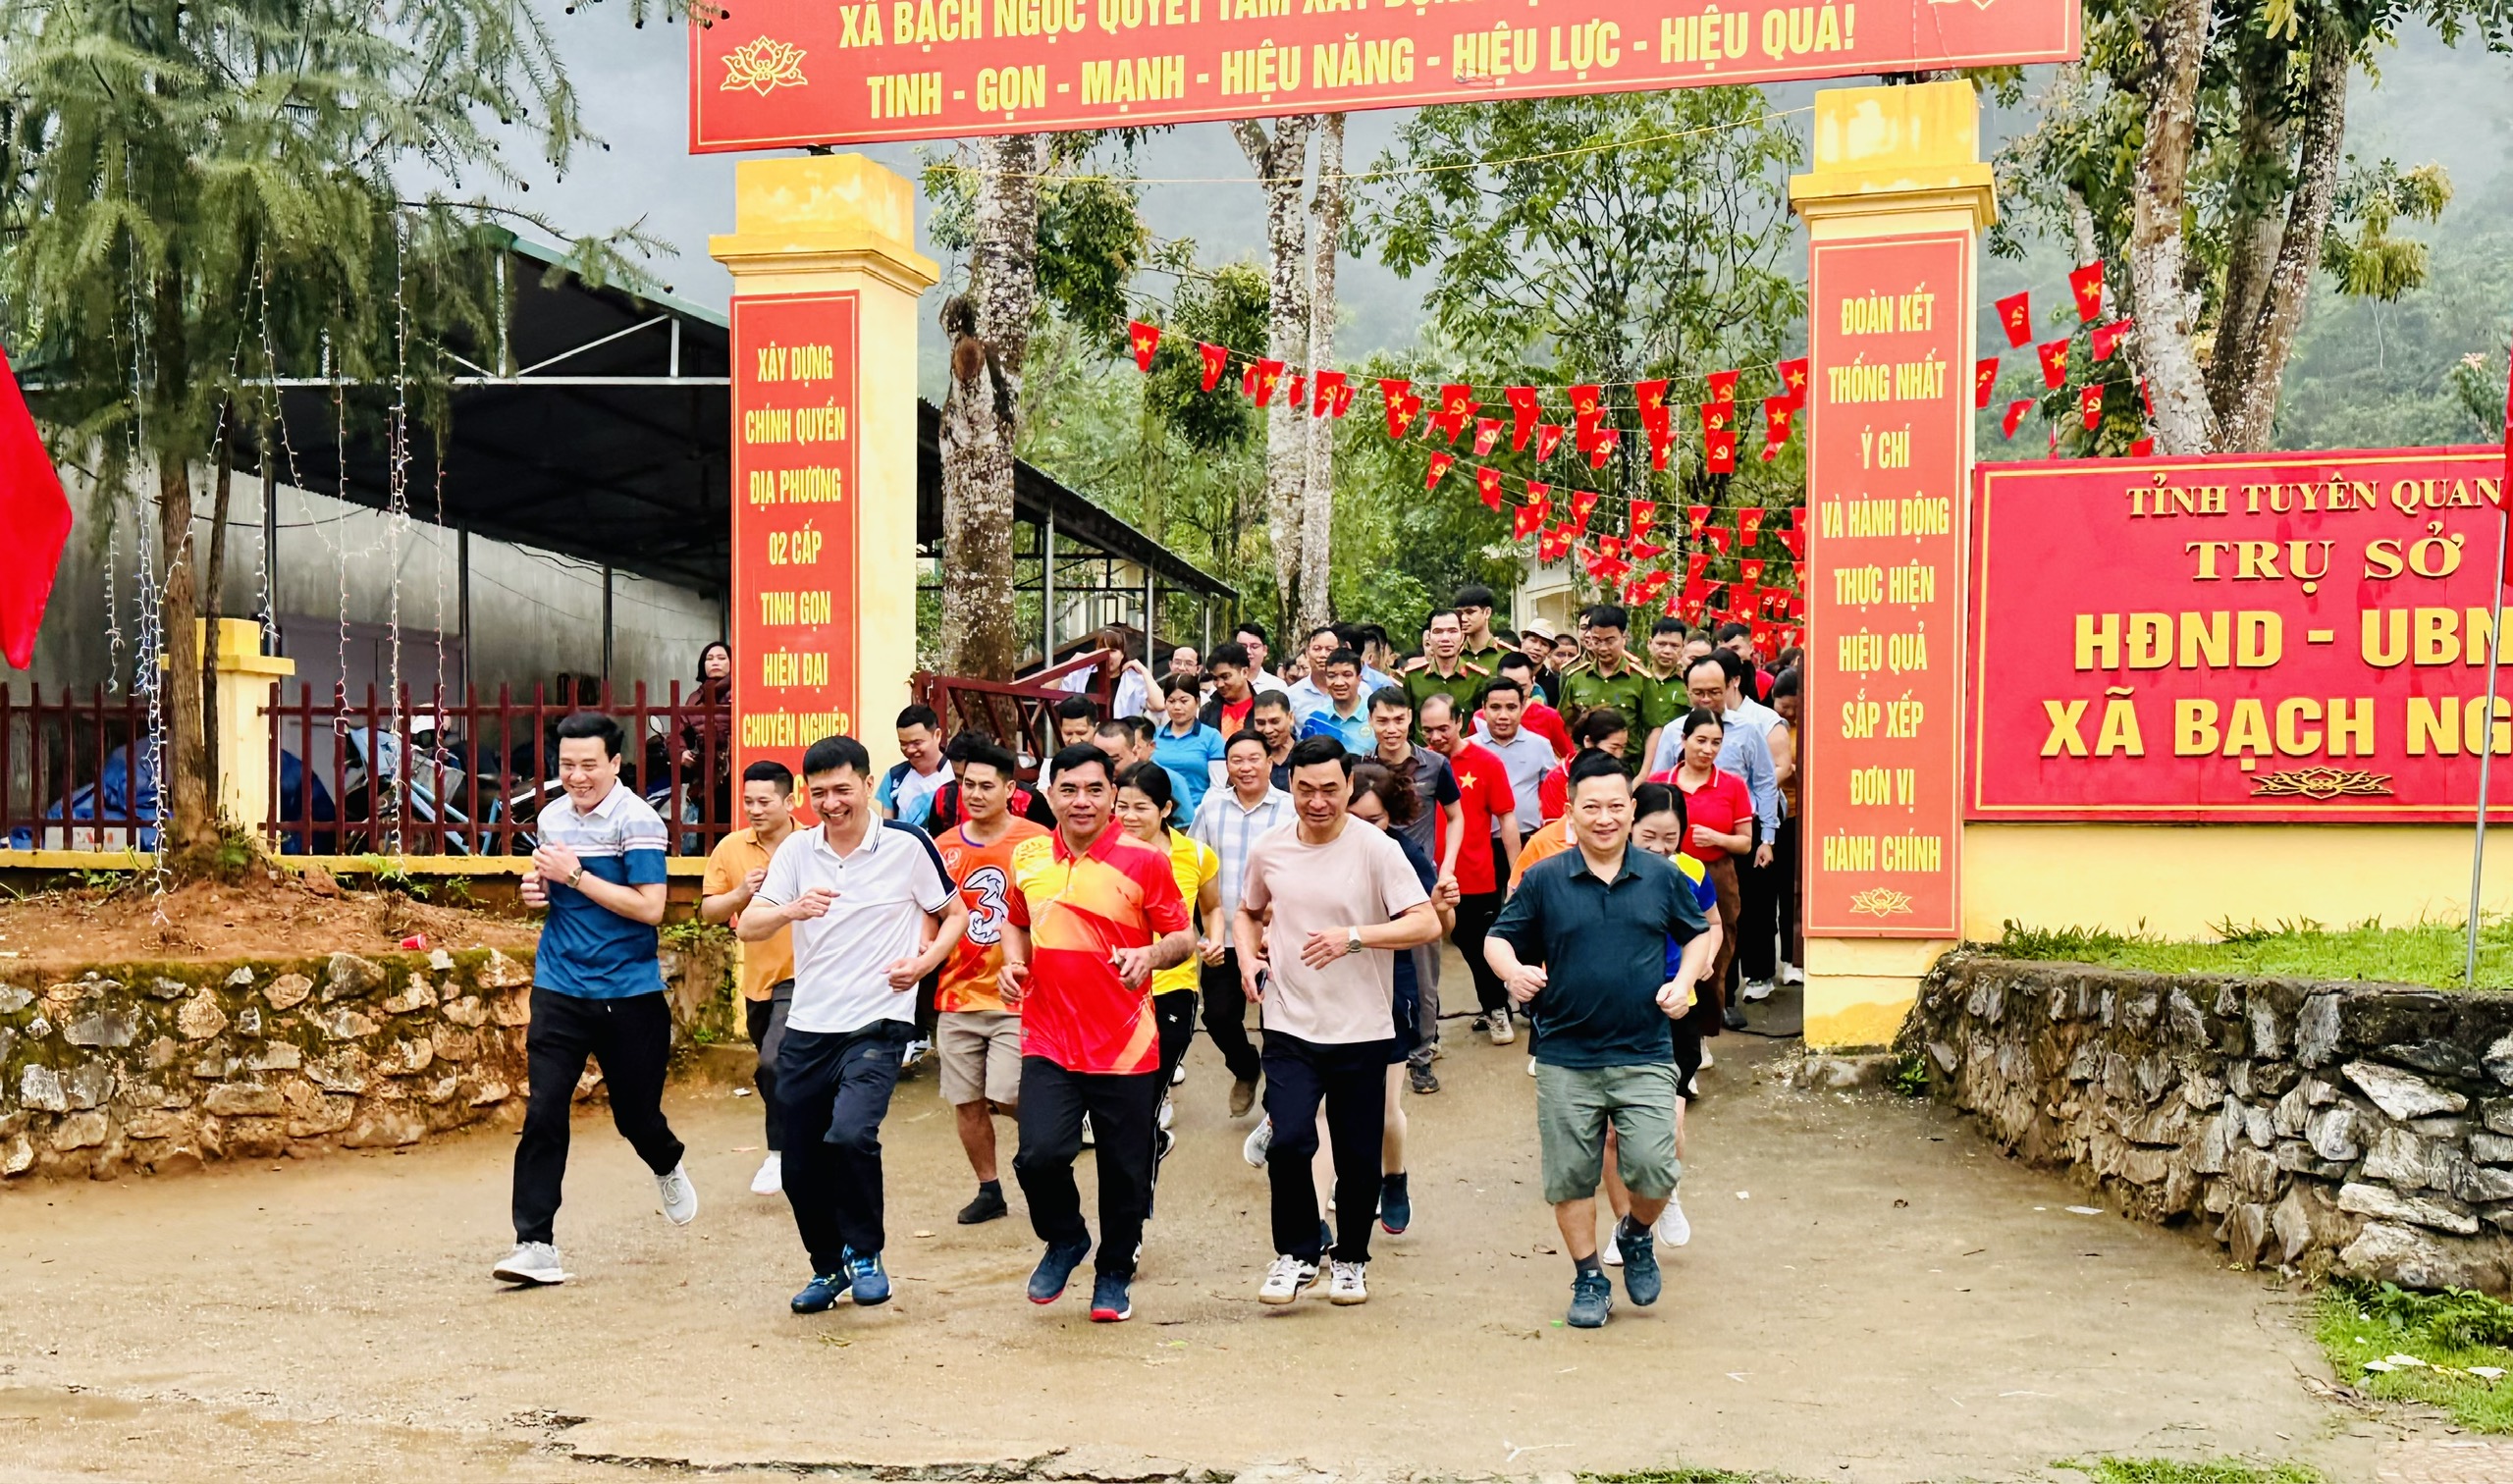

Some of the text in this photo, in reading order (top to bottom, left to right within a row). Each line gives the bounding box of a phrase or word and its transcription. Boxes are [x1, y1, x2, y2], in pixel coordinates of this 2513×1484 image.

[894, 0, 983, 53] BẠCH
[993, 0, 1087, 44] NGỌC
[867, 72, 942, 119] TINH
[977, 65, 1045, 120] GỌN
[1081, 55, 1185, 112] MẠNH
[1221, 38, 1301, 102] HIỆU
[1312, 31, 1415, 89] NĂNG
[1453, 21, 1537, 85] HIỆU
[1550, 19, 1621, 80] LỰC
[1661, 4, 1749, 71] HIỆU
[1841, 281, 1935, 336] ĐOÀN KẾT
[757, 341, 833, 388] XÂY DỰNG
[1828, 347, 1947, 403] THỐNG NHẤT
[745, 402, 791, 445] CHÍNH
[1861, 423, 1910, 469] Ý CHÍ
[749, 464, 841, 512] ĐỊA PHƯƠNG
[2126, 471, 2503, 518] TỈNH TUYÊN QUAN
[769, 518, 823, 565] 02 CẤP
[1821, 490, 1950, 544] VÀ HÀNH ĐỘNG
[2185, 520, 2465, 594] TRỤ SỞ
[1834, 557, 1935, 612] THỰC HIỆN
[761, 591, 831, 632] TINH GỌN
[1839, 620, 1928, 680] HIỆU QUẢ
[2074, 610, 2283, 669] HĐND
[2361, 607, 2513, 667] UBN
[763, 646, 829, 694] HIỆN ĐẠI
[742, 706, 795, 748] CHUYÊN
[1842, 688, 1924, 739] SẮP XẾP
[2040, 686, 2146, 757] XÃ
[2174, 697, 2376, 771] BẠCH
[1850, 765, 1914, 814] ĐƠN VỊ
[1823, 827, 1942, 873] HÀNH CHÍNH
